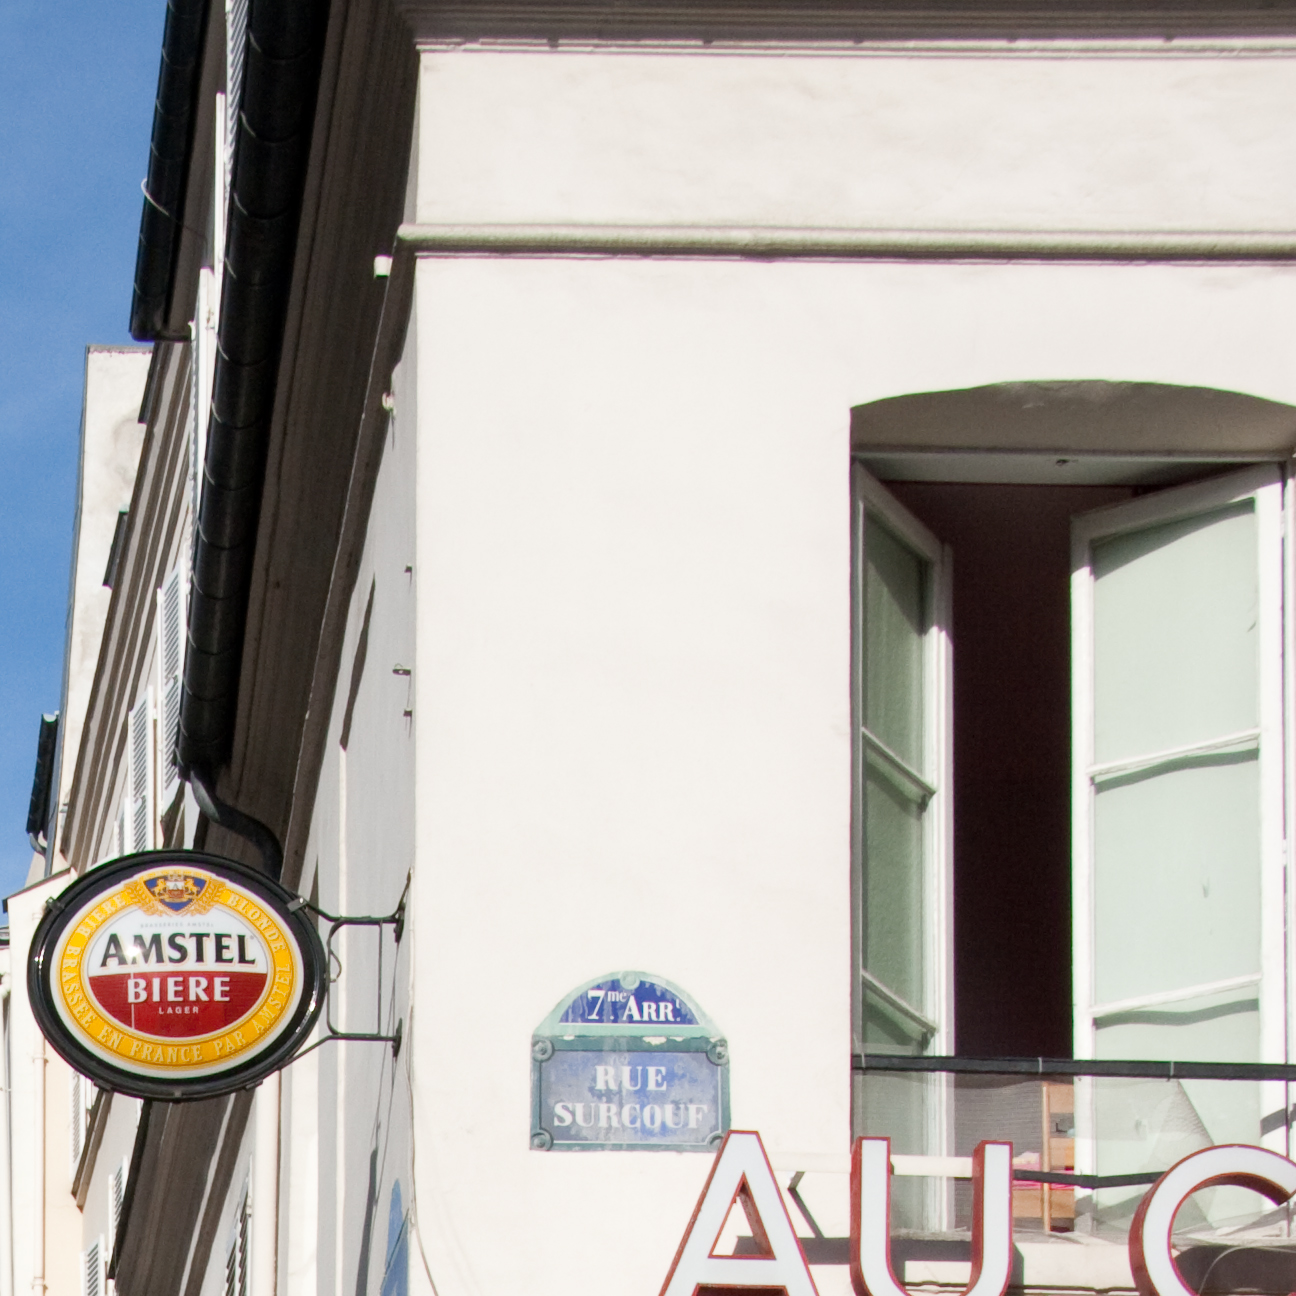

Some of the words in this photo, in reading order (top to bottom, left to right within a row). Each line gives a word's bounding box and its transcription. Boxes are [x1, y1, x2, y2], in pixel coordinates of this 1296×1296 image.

[229, 893, 286, 953] BLONDE
[100, 932, 255, 968] AMSTEL
[128, 976, 230, 1003] BIERE
[99, 1026, 123, 1050] EN
[130, 1041, 203, 1063] FRANCE
[214, 1033, 246, 1056] PAR
[253, 964, 292, 1036] AMSTEL
[158, 1006, 199, 1015] LAGER
[595, 1065, 667, 1091] RUE
[554, 1102, 707, 1129] SURCOUF
